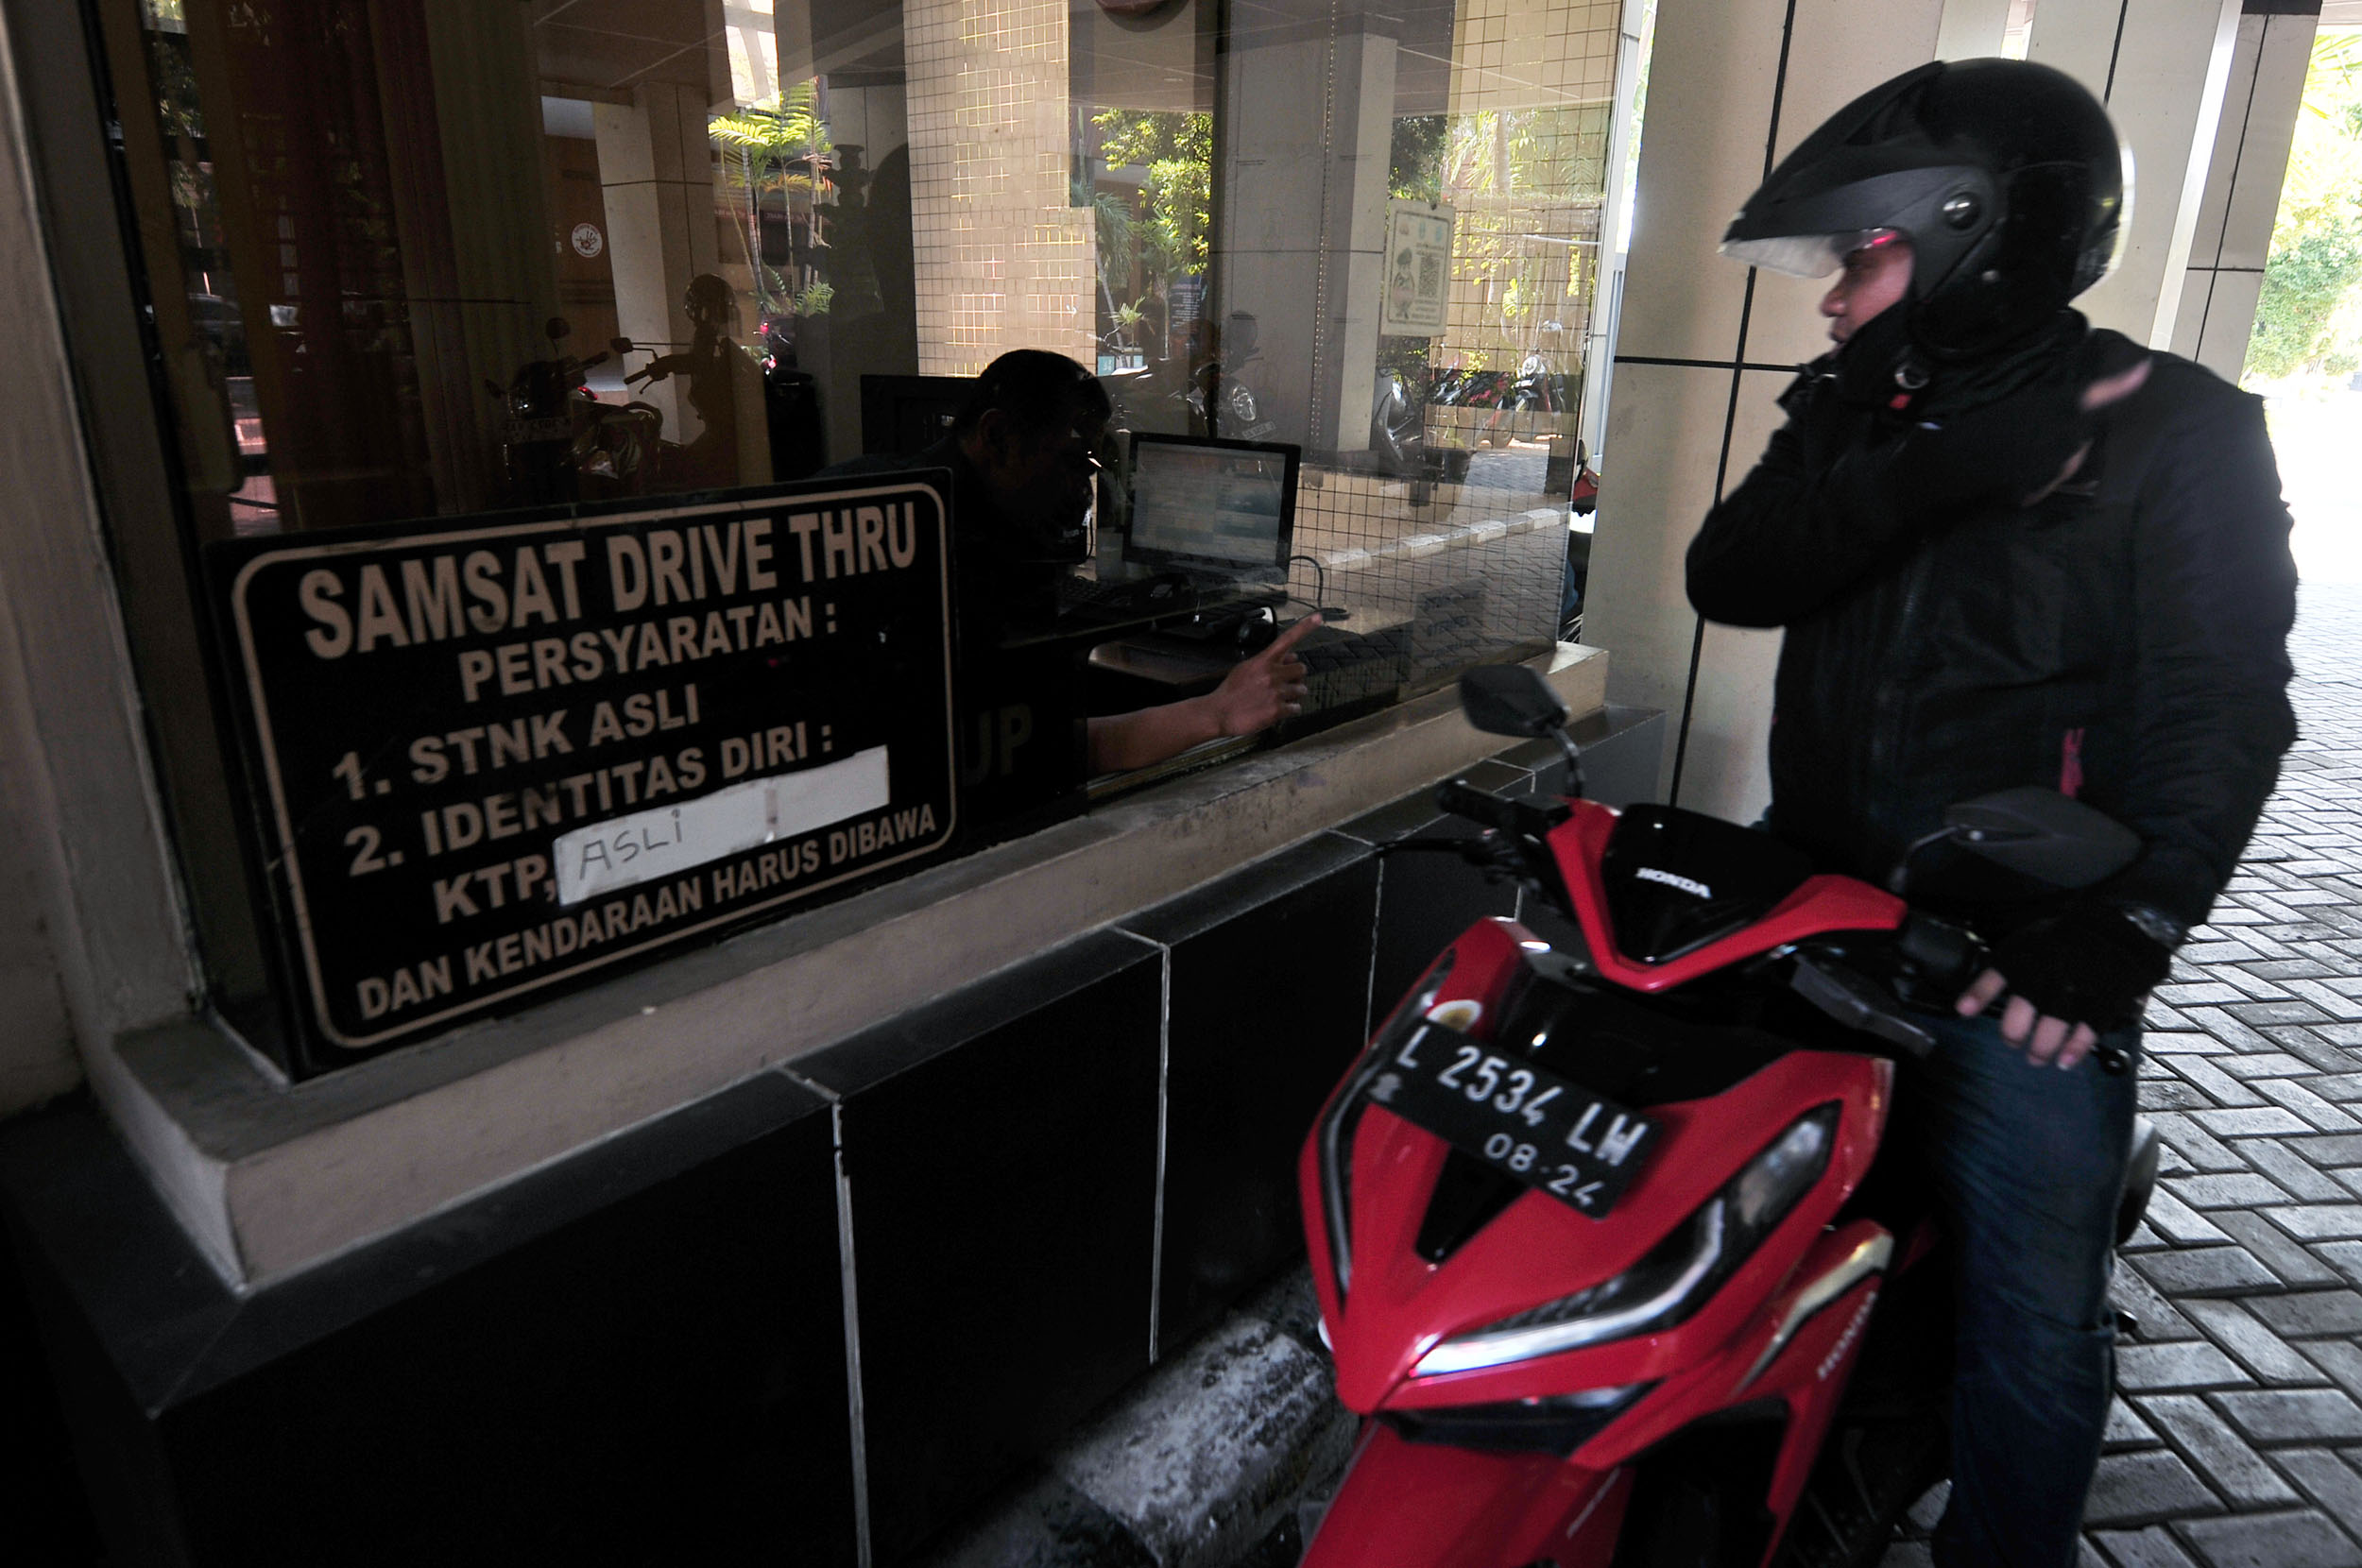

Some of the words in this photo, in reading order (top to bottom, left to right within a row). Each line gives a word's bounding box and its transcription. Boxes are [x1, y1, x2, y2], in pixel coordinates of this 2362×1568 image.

[298, 541, 586, 660] SAMSAT
[608, 517, 779, 612] DRIVE
[789, 502, 917, 583] THRU
[459, 596, 813, 703] PERSYARATAN
[333, 751, 390, 801] 1.
[409, 711, 574, 784] STNK
[589, 683, 701, 746] ASLI
[343, 826, 405, 877] 2.
[421, 747, 707, 857] IDENTITAS
[721, 722, 808, 779] DIRI
[355, 971, 453, 1021] DAN
[465, 876, 703, 985] KENDARAAN
[711, 840, 821, 903] HARUS
[828, 804, 938, 864] DIBAWA
[1395, 1024, 1431, 1069] L
[1436, 1045, 1565, 1127] 2534
